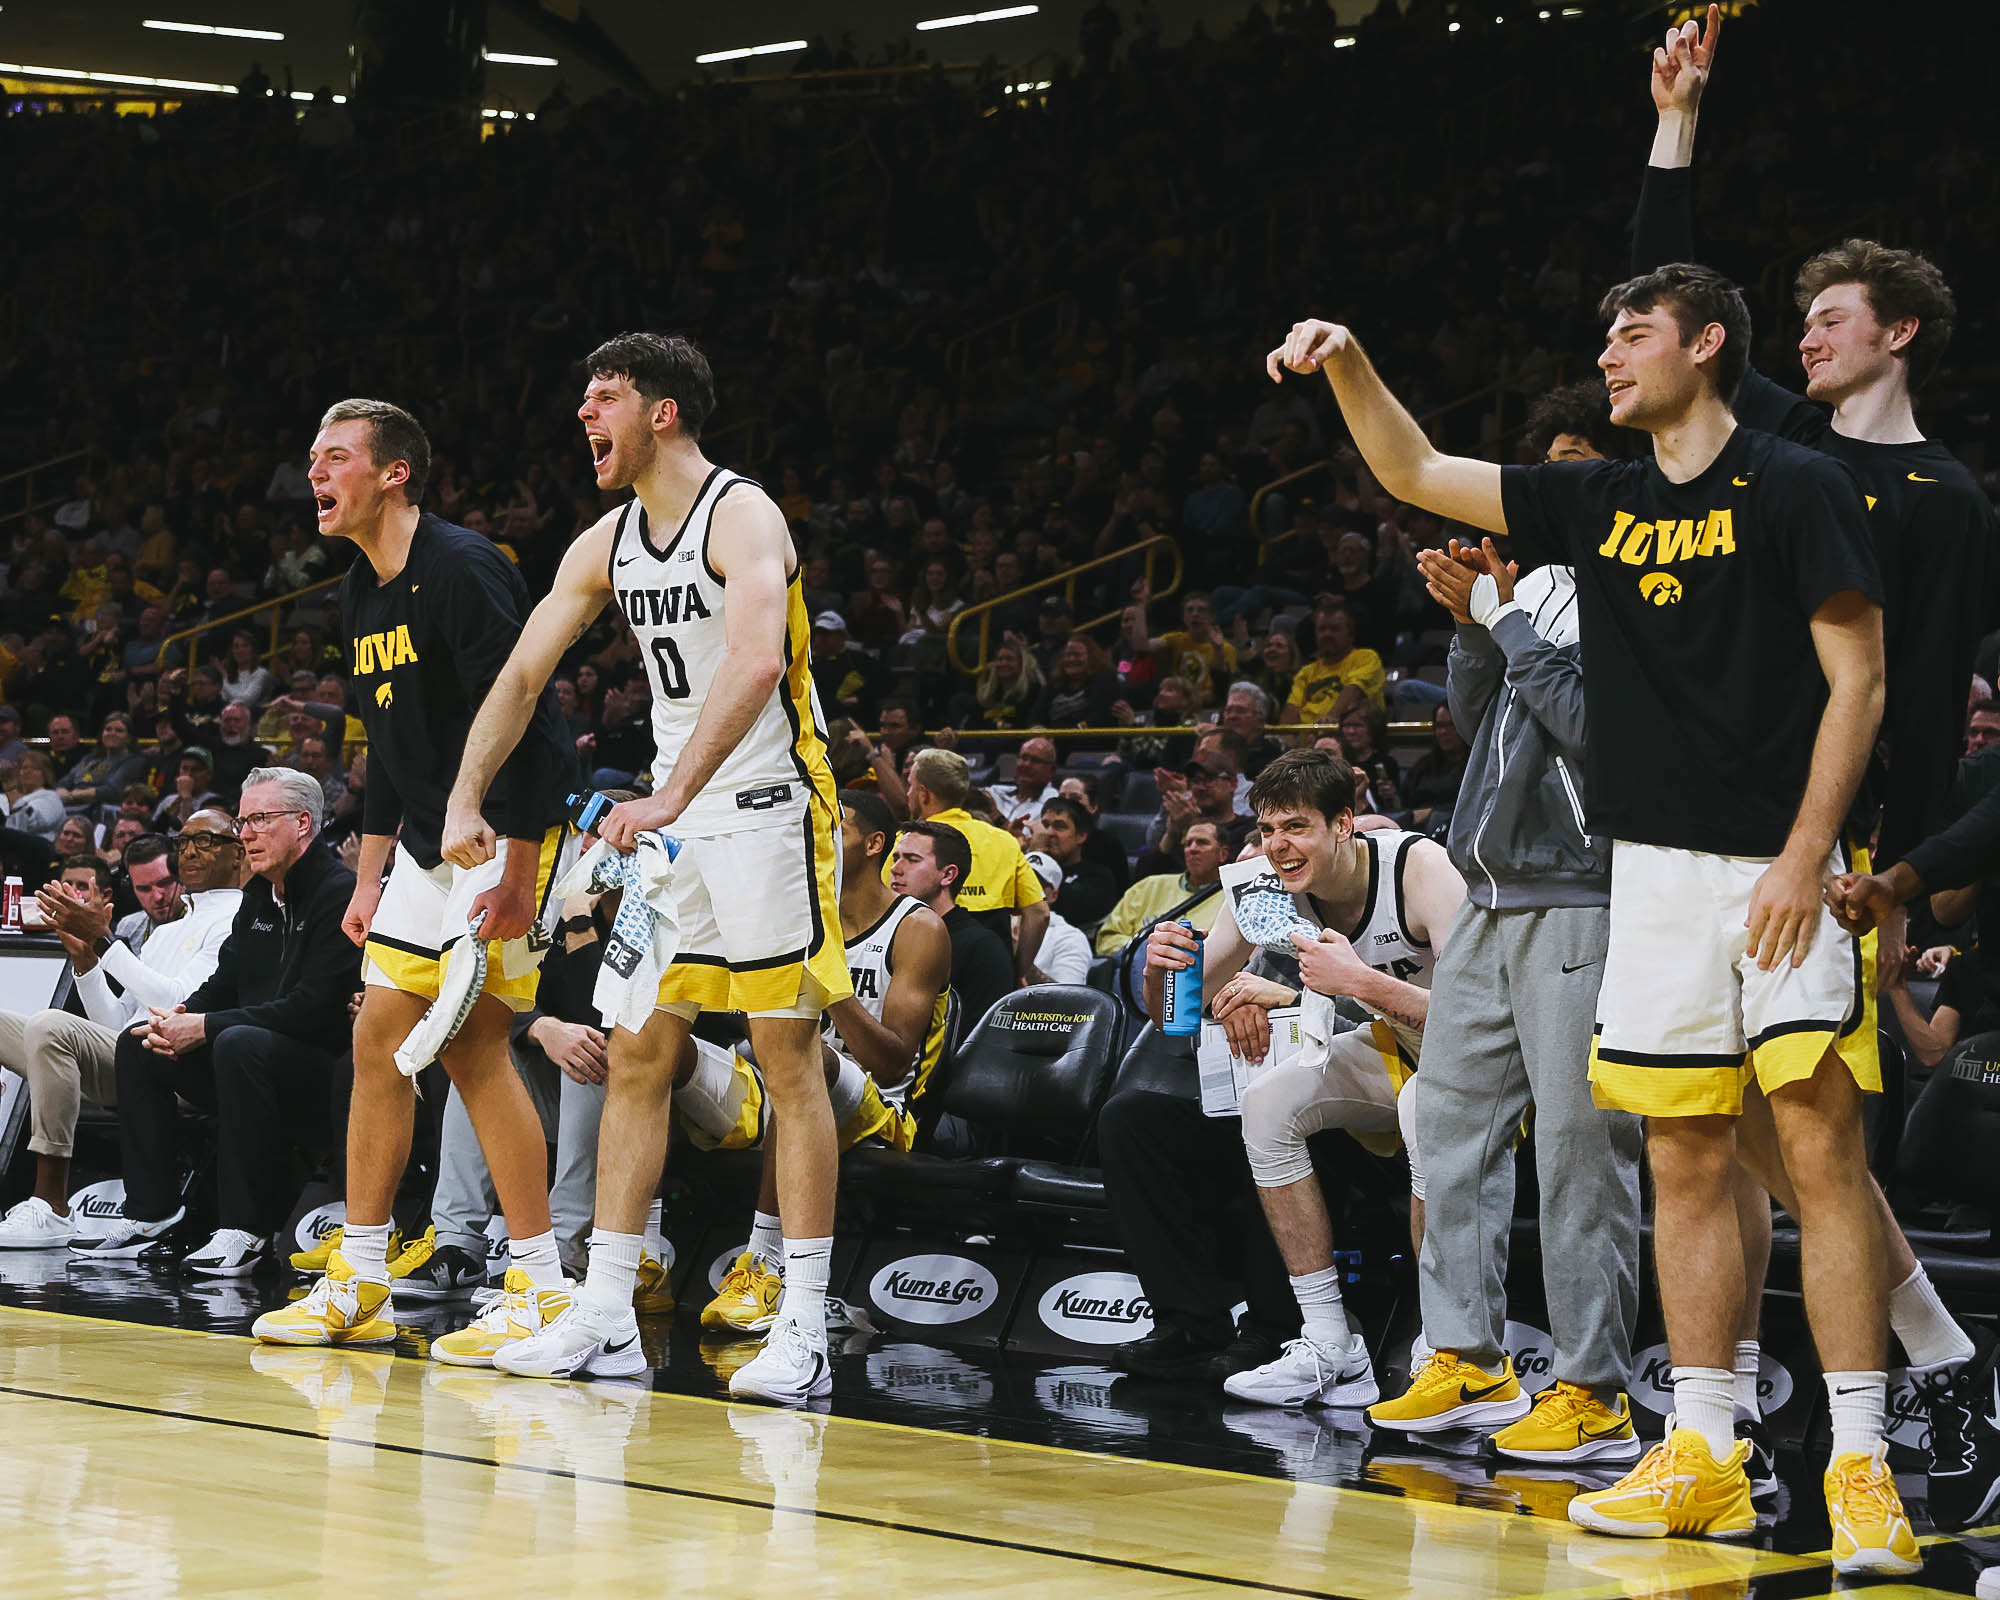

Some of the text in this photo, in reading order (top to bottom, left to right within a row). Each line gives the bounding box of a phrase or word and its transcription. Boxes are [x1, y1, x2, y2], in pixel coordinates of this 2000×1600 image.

[1599, 509, 1736, 566] IOWA
[618, 583, 712, 626] IOWA
[651, 637, 691, 699] 0
[1011, 1021, 1073, 1033] HEALTH CARE
